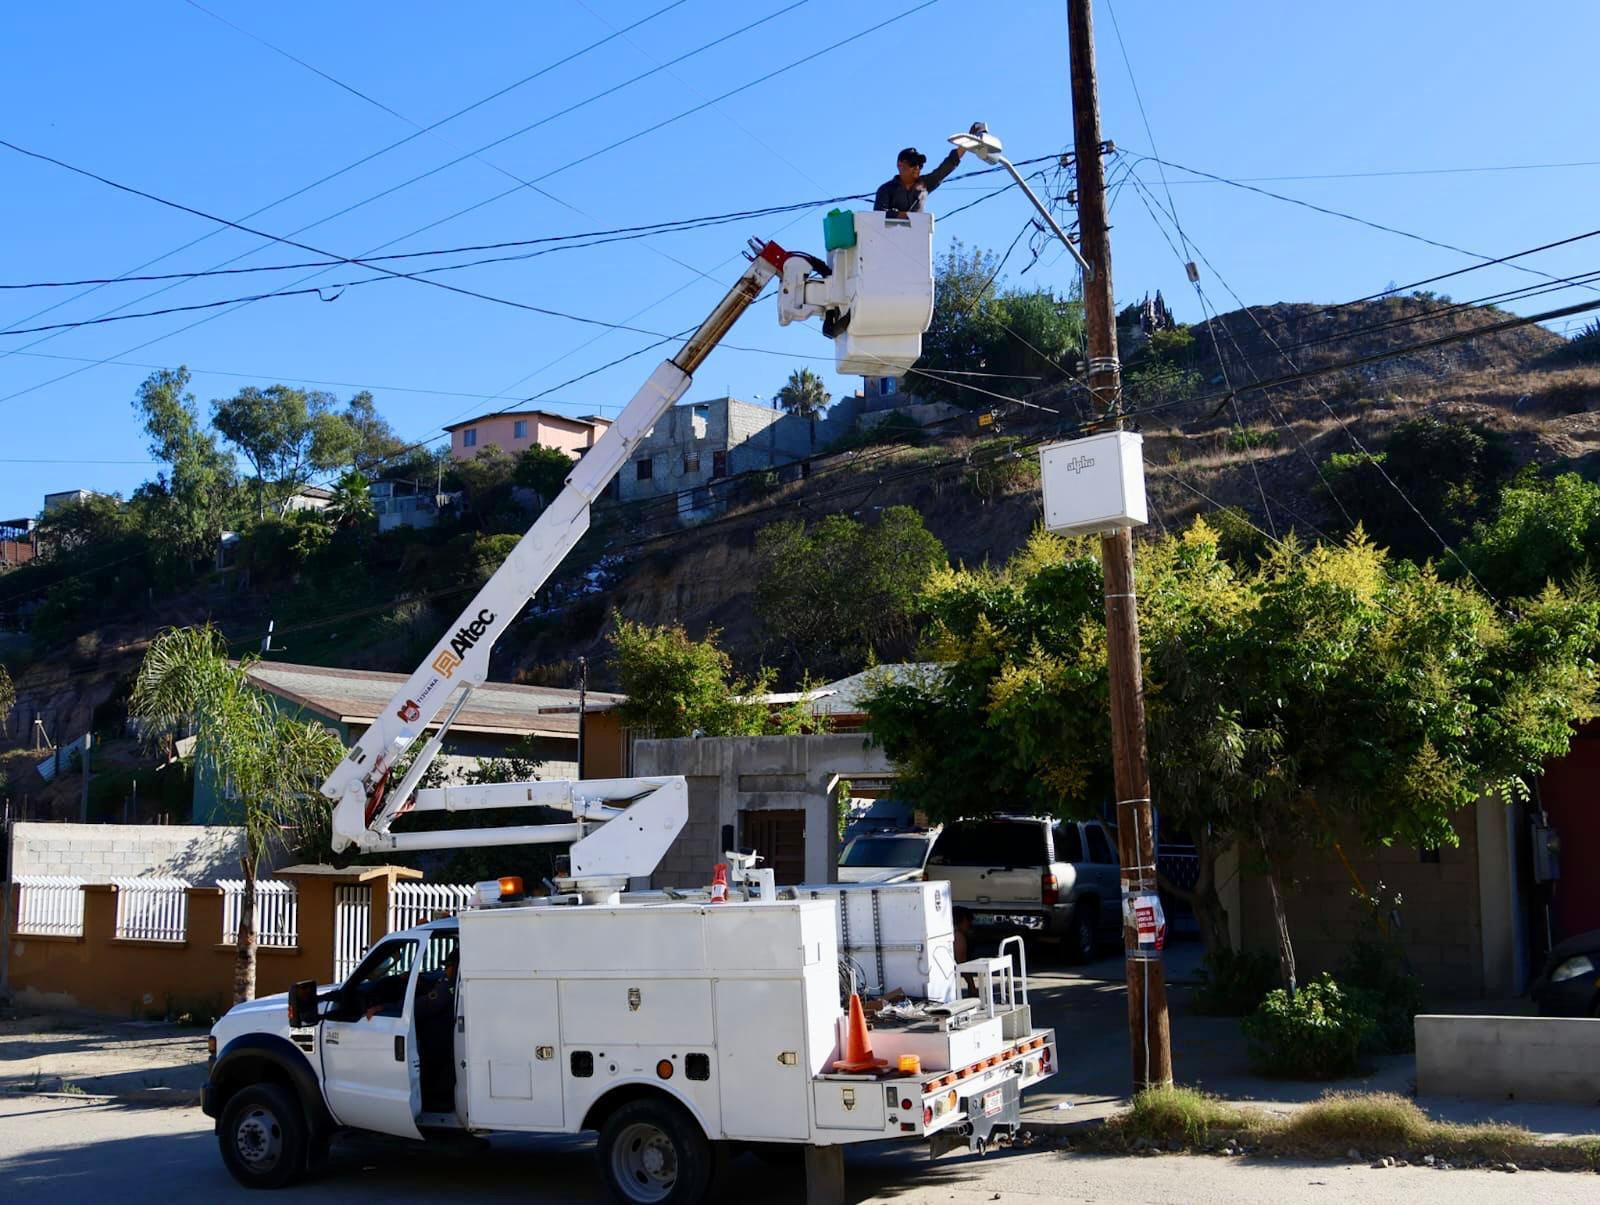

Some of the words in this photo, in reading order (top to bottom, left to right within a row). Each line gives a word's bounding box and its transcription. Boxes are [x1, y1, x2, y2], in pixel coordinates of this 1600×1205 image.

[1066, 455, 1095, 474] alpha
[450, 608, 495, 660] Altec
[416, 678, 439, 704] TIJUANA
